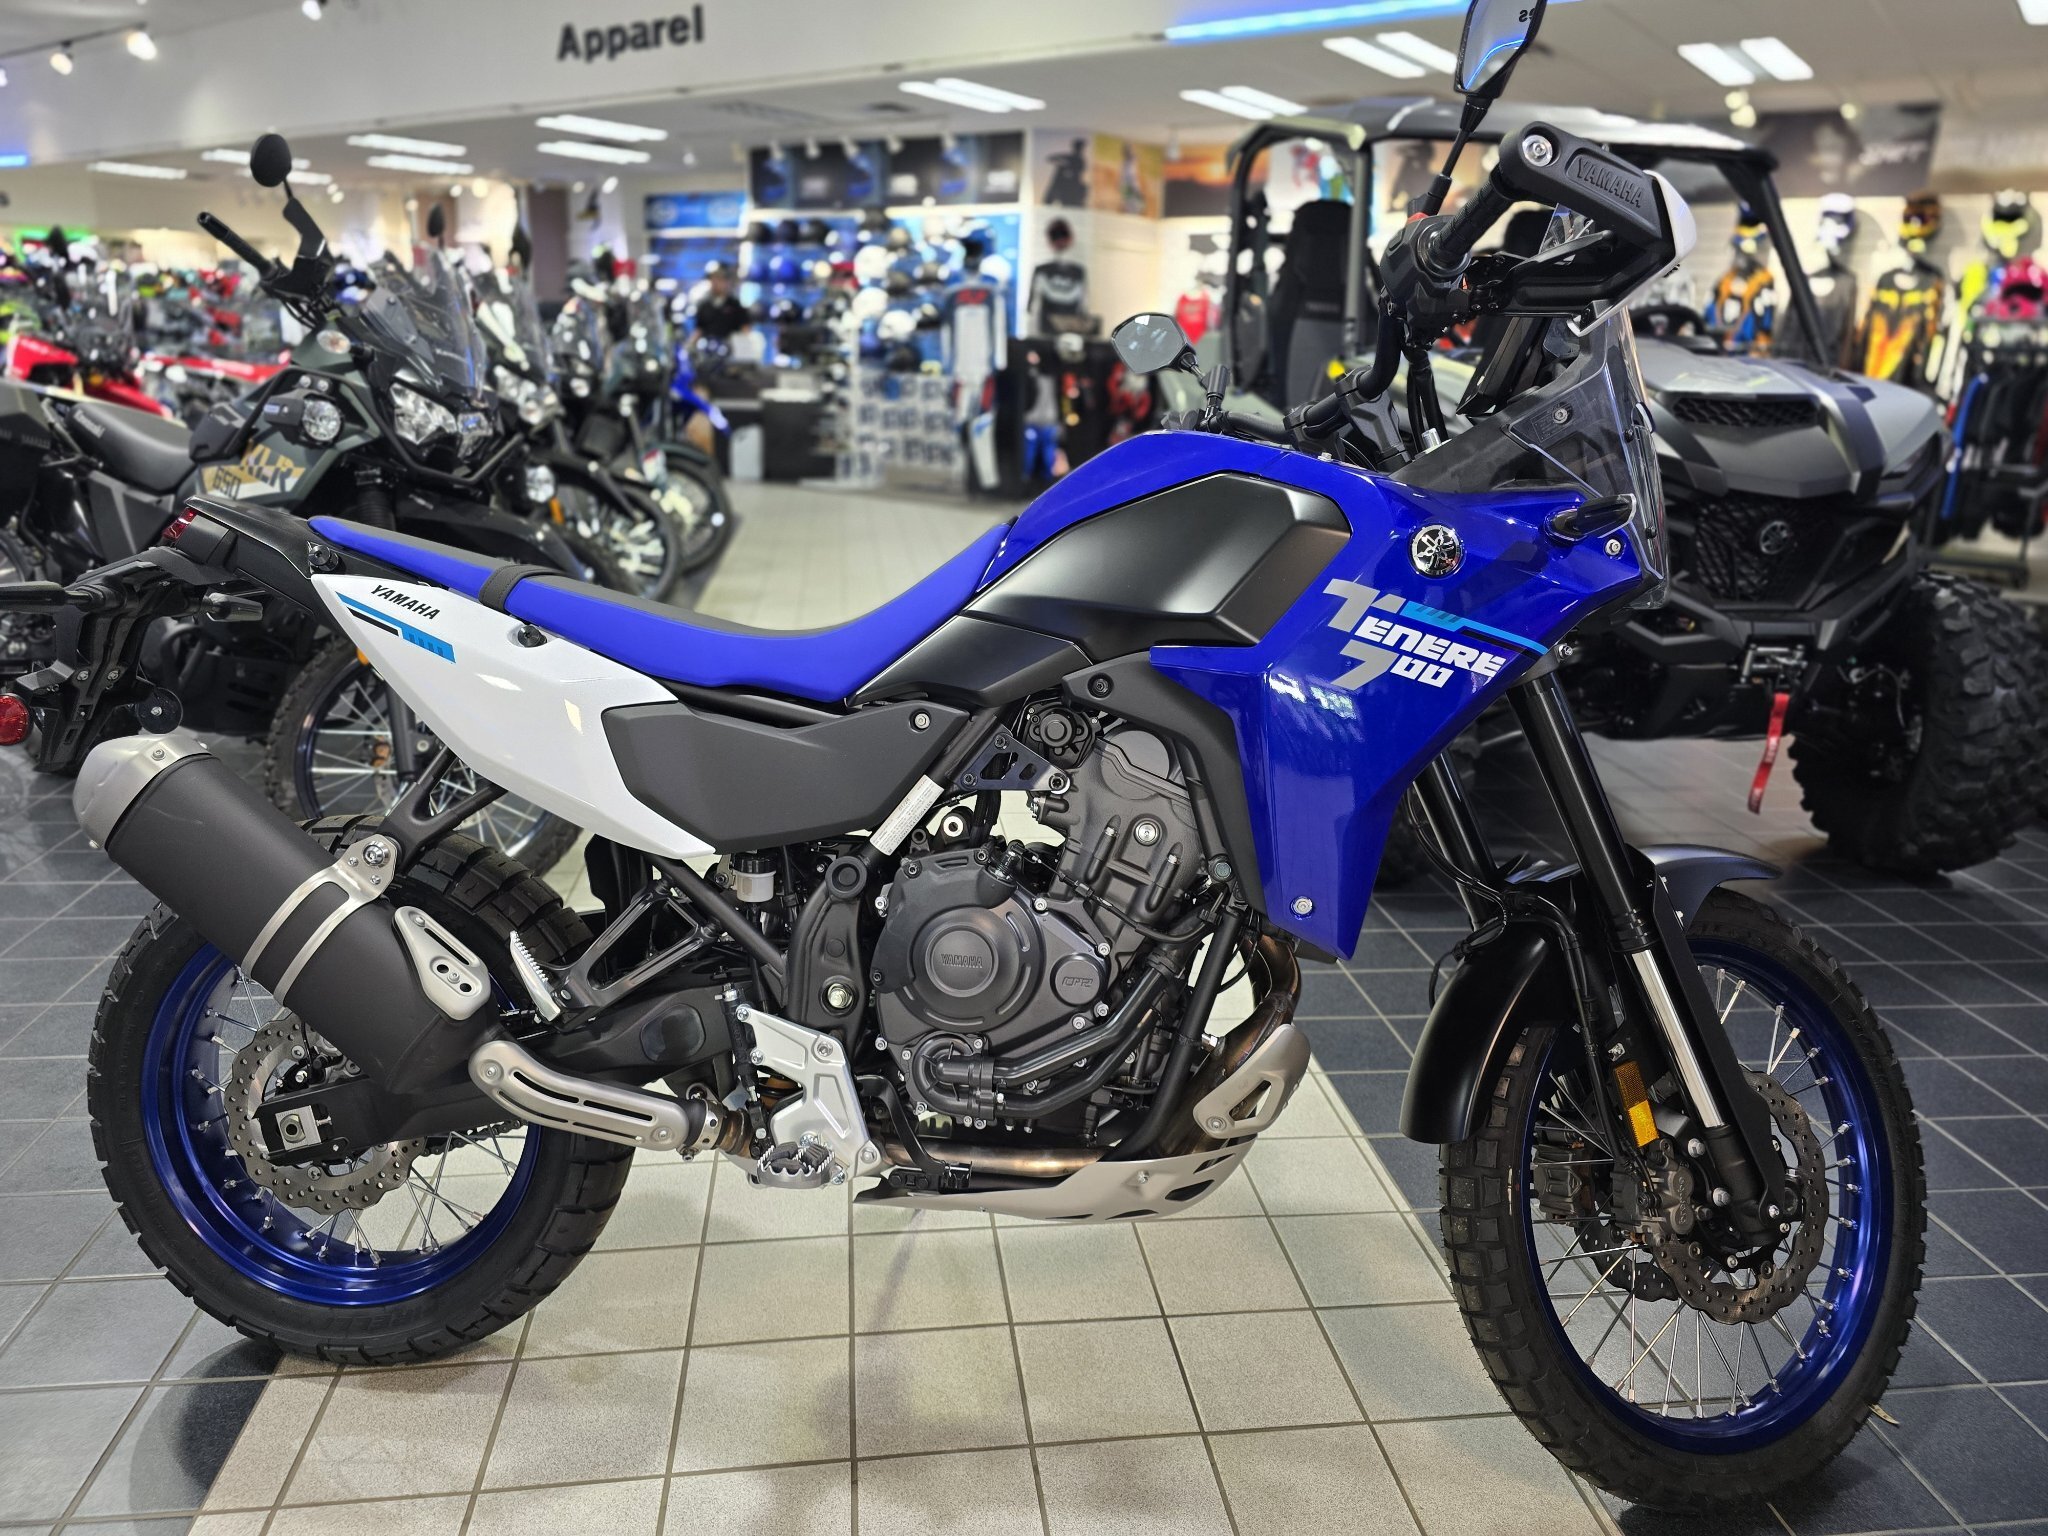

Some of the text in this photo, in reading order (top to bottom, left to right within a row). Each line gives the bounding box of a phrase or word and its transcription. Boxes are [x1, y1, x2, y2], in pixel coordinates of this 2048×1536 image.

[556, 3, 705, 64] Apparel
[1577, 157, 1643, 208] YAMAHA
[212, 466, 242, 500] 650
[239, 443, 296, 493] KLR
[370, 584, 441, 620] YAMAHA
[1330, 639, 1455, 691] 700
[940, 952, 984, 970] YAMAHA
